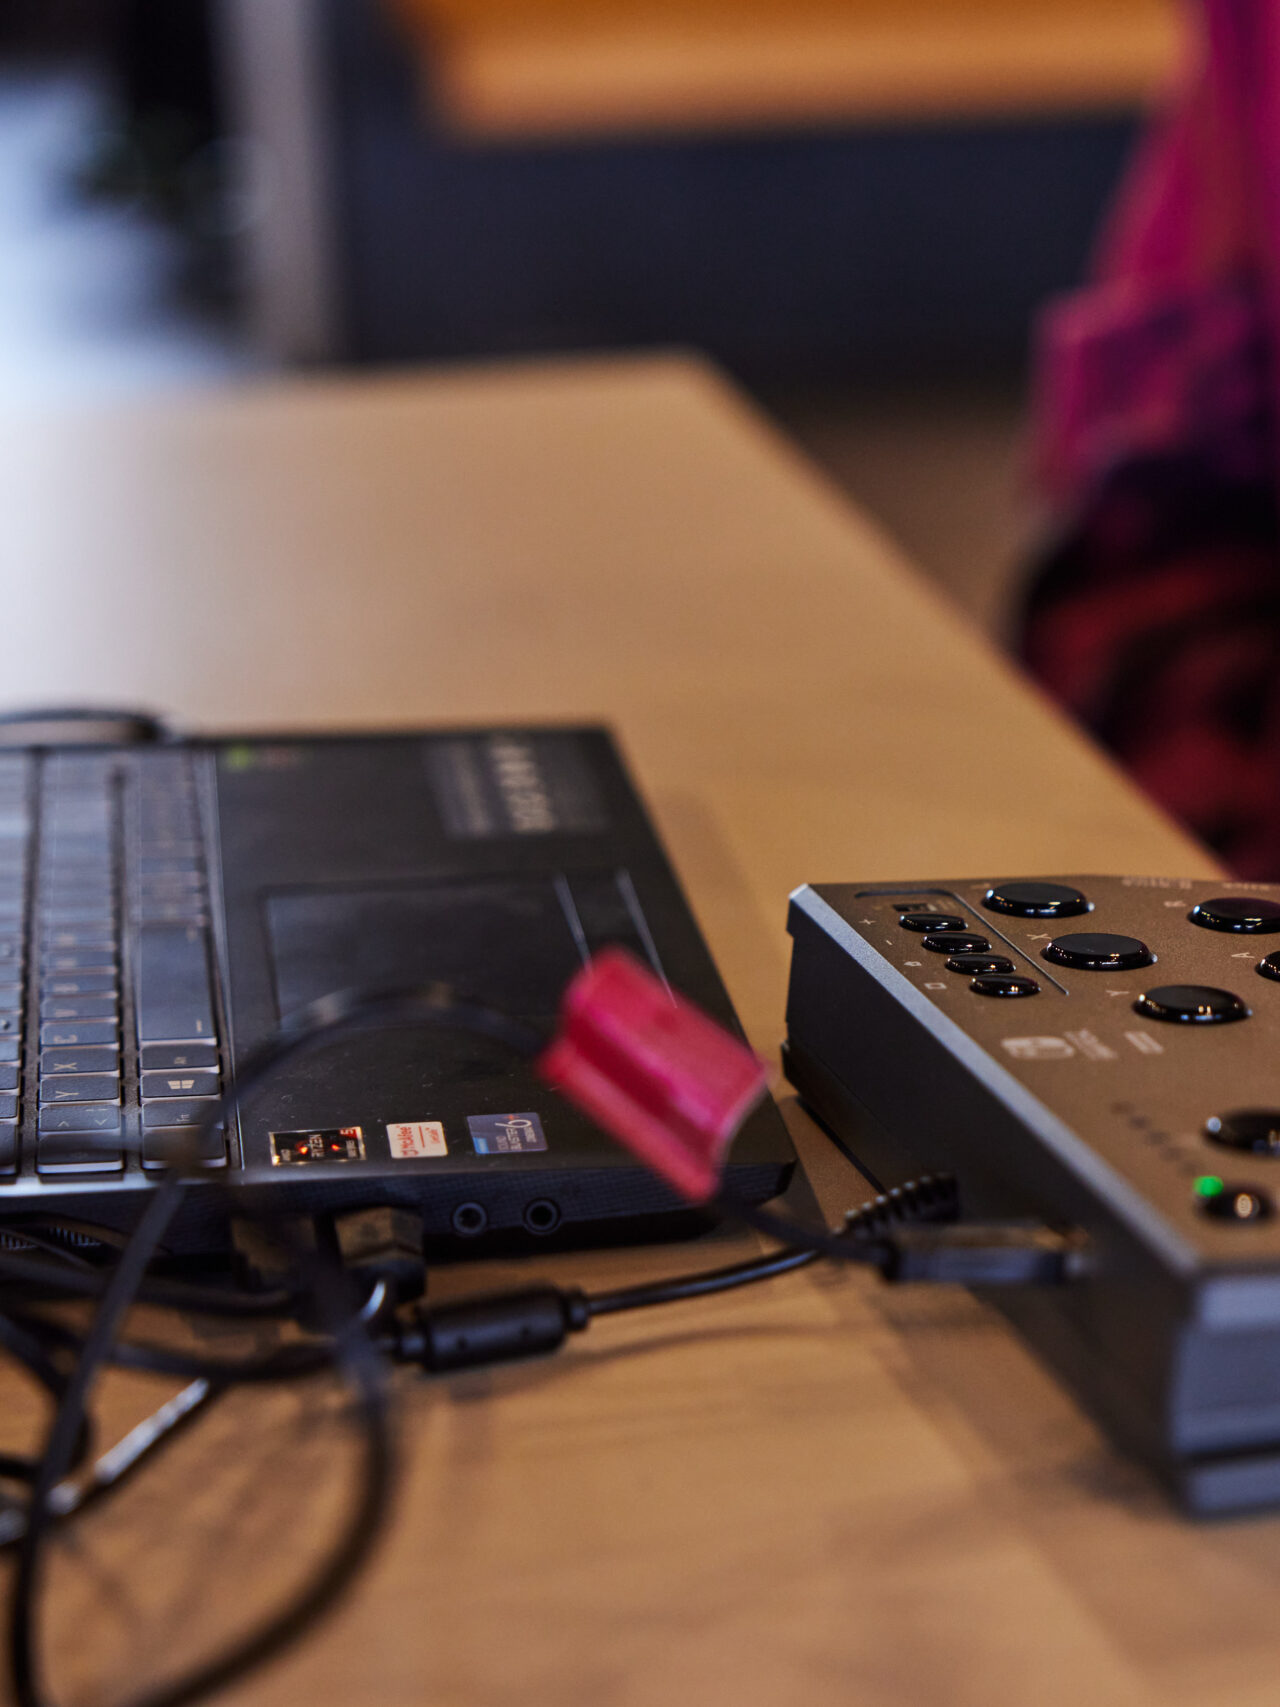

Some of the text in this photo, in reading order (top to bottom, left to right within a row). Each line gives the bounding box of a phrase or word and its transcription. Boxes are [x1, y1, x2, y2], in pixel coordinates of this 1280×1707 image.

[1026, 932, 1053, 941] X
[1231, 951, 1255, 960] A
[53, 1061, 78, 1071] X
[55, 1090, 79, 1099] Y
